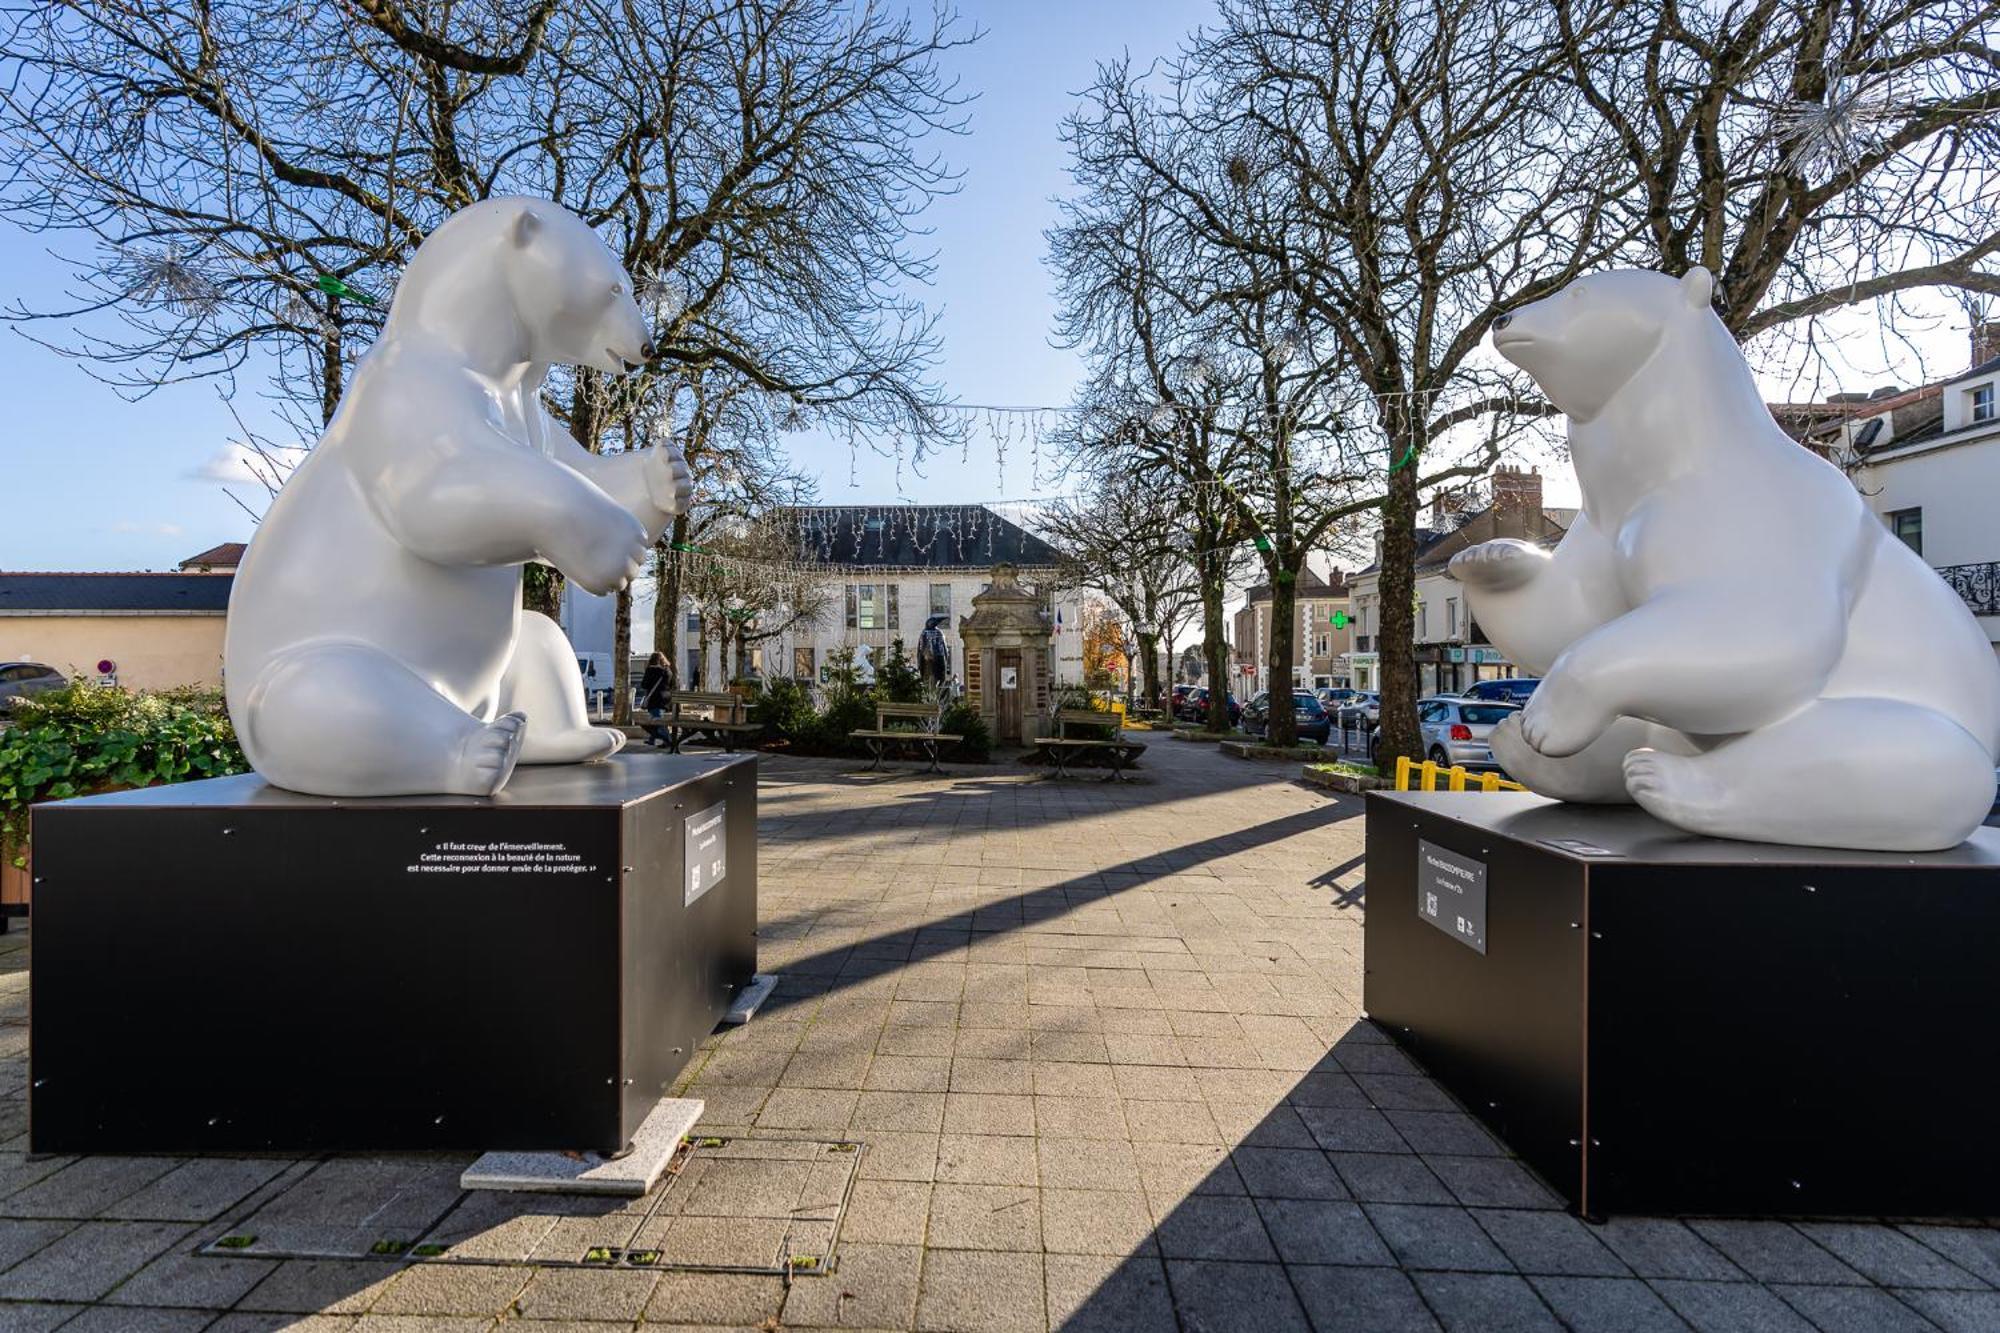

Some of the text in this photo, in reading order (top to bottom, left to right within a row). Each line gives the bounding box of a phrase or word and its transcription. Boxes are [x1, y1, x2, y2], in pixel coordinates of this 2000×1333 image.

[450, 842, 466, 851] faut
[488, 842, 499, 851] de
[420, 853, 442, 861] Cette
[443, 853, 490, 861] reconnexion
[498, 853, 506, 861] la
[507, 853, 533, 861] beauté
[535, 853, 545, 861] de
[546, 853, 554, 861] la
[555, 853, 581, 861] nature
[461, 865, 481, 873] pour
[481, 864, 510, 872] donner
[512, 864, 532, 872] envie
[533, 864, 544, 872] de
[545, 864, 553, 872] la
